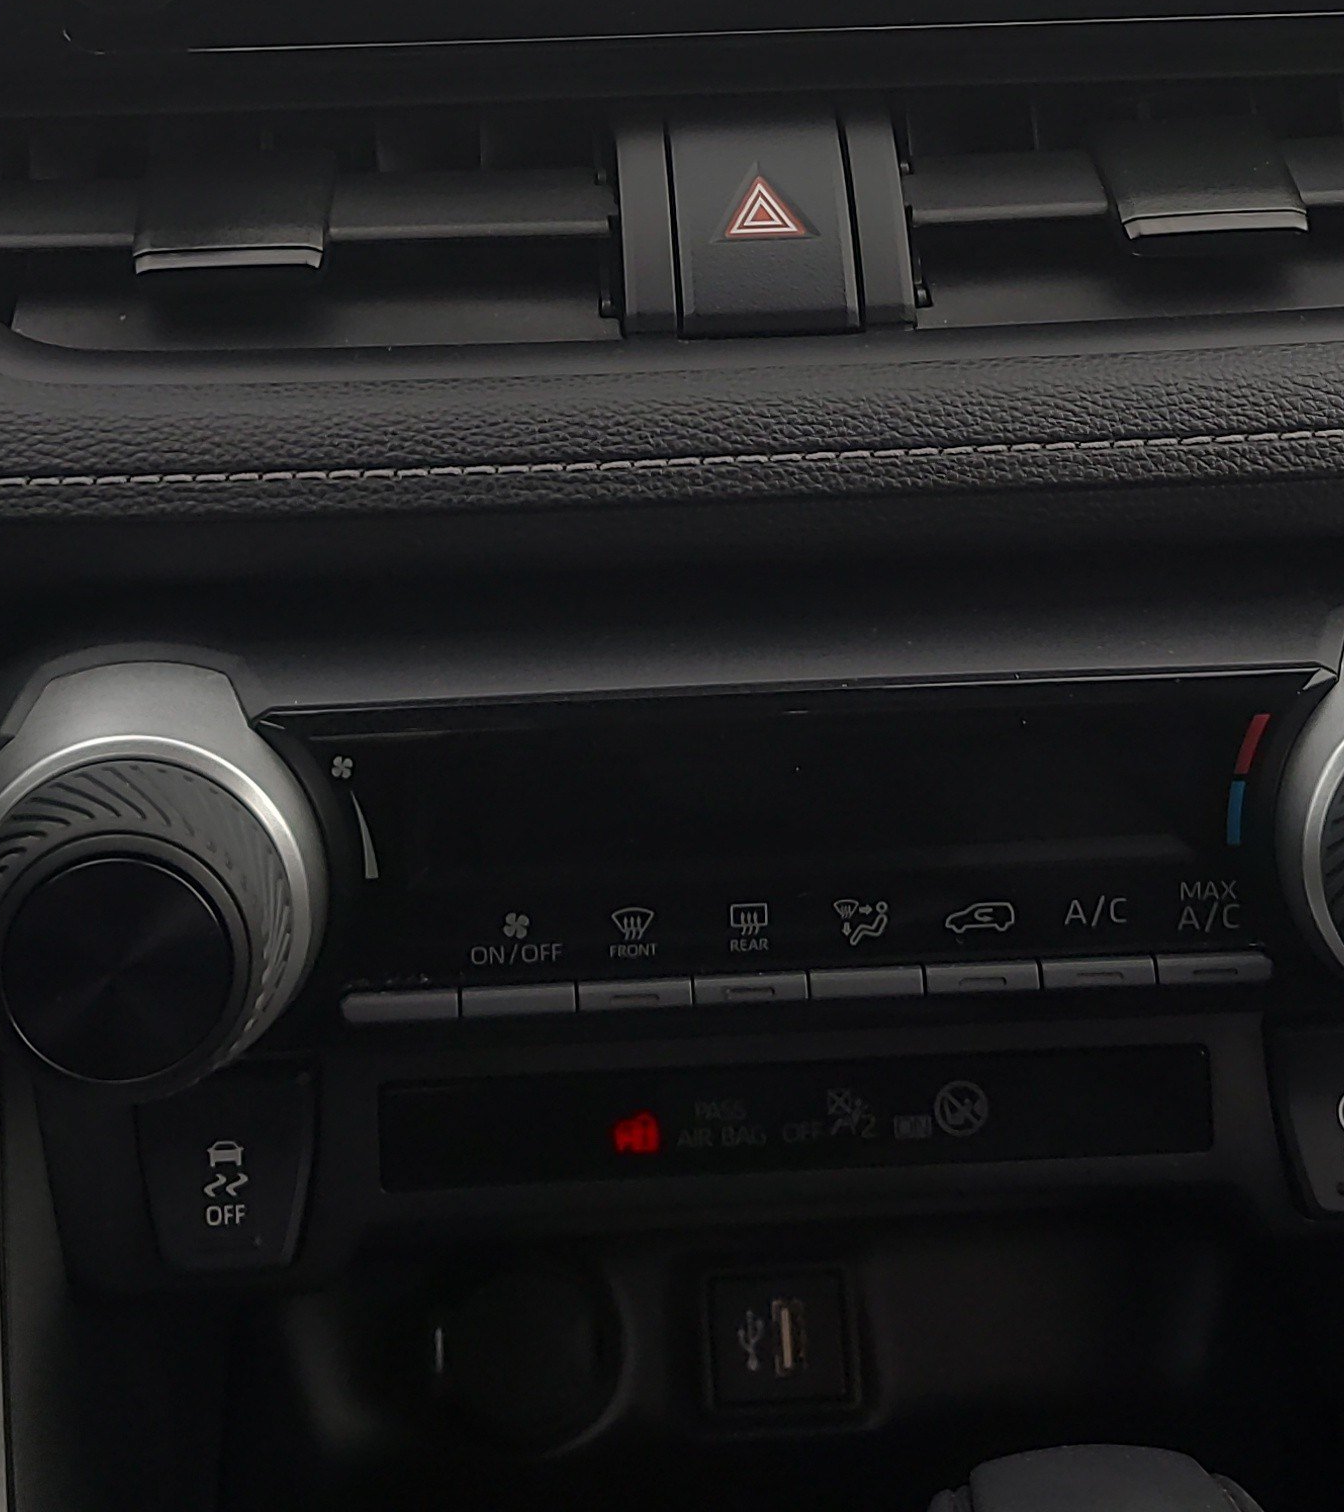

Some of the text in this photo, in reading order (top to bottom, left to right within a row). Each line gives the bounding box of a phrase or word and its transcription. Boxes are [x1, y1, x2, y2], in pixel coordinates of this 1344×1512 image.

[1179, 879, 1238, 901] MAX
[1064, 894, 1128, 926] A/C
[1177, 901, 1241, 934] A/C
[470, 942, 563, 967] ON/OFF
[609, 941, 659, 958] FRONT
[729, 935, 770, 953] REAR
[694, 1098, 748, 1122] PASS
[676, 1120, 824, 1149] AIR BAG OFF
[205, 1204, 247, 1227] OFF
